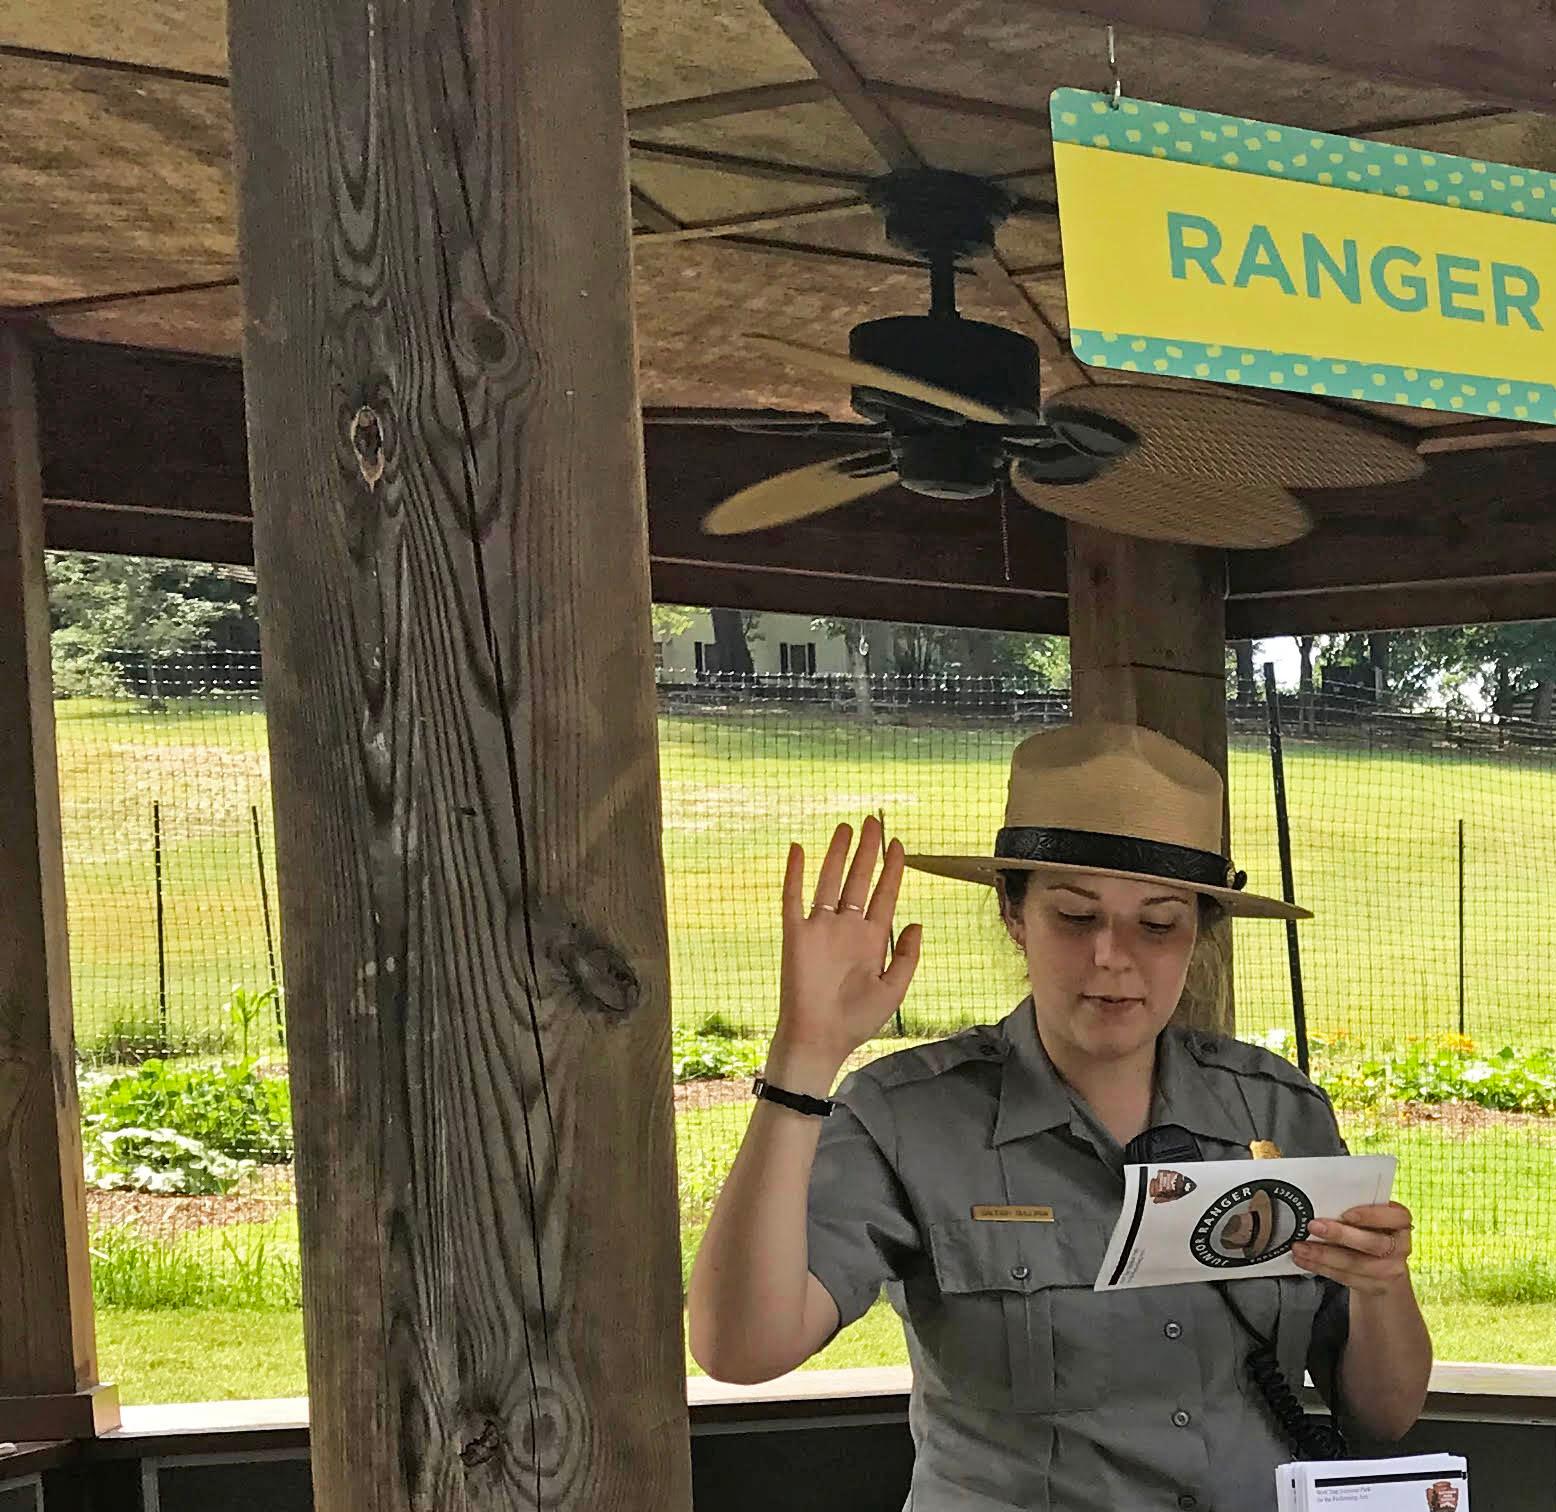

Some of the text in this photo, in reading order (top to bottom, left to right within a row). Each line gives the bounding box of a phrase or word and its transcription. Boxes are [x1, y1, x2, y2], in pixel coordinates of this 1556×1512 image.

[1165, 210, 1545, 331] RANGER
[1194, 1187, 1252, 1266] JUNIOR RANGER
